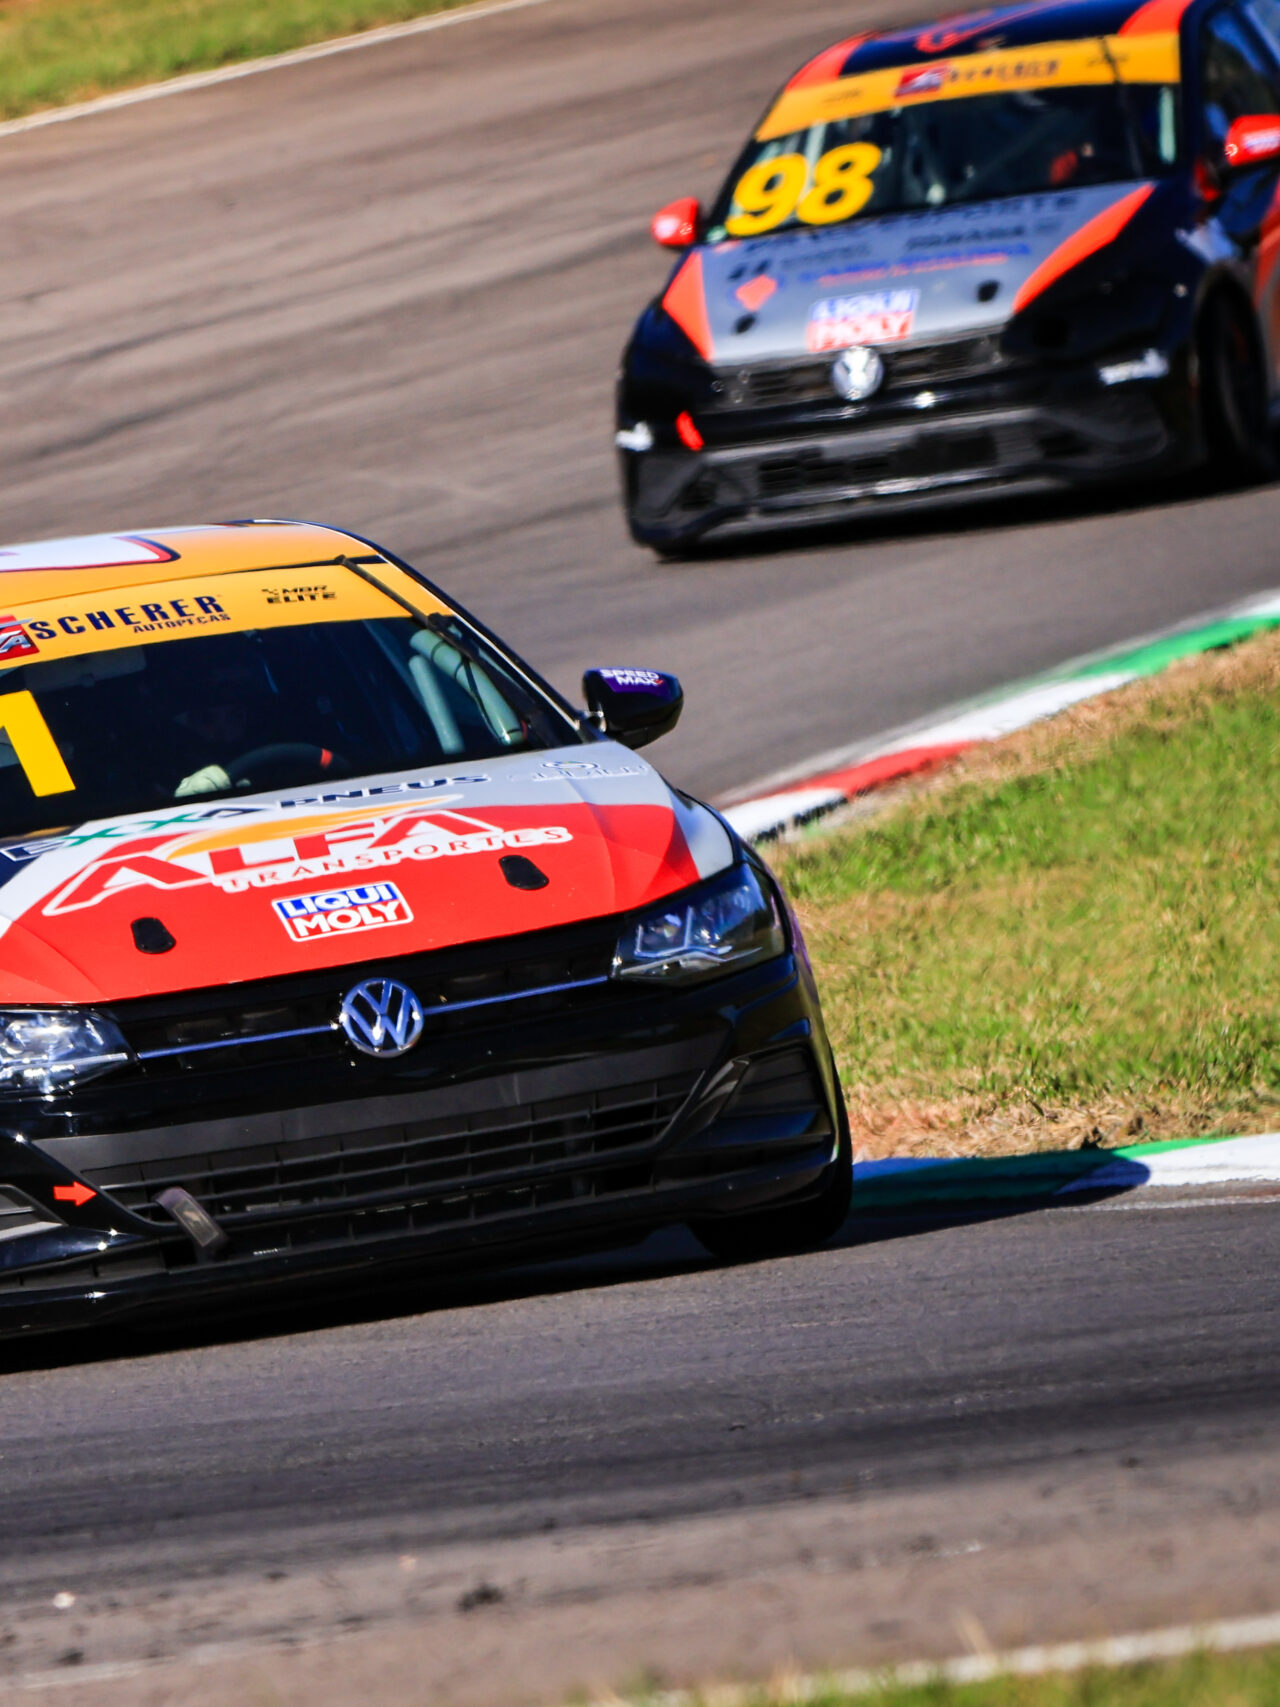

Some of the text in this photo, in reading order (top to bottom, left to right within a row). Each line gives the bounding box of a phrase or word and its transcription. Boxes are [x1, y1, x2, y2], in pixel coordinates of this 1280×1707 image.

[724, 142, 882, 236] 98
[267, 592, 337, 604] ELITE
[28, 596, 224, 639] SCHERER
[600, 669, 659, 680] SPEED
[616, 676, 658, 686] MAX
[279, 774, 491, 809] PNEUS
[45, 811, 497, 914] ALFA
[220, 827, 568, 890] TRANSPORTES
[282, 884, 394, 918] LIQUI
[292, 901, 400, 937] MOLY
